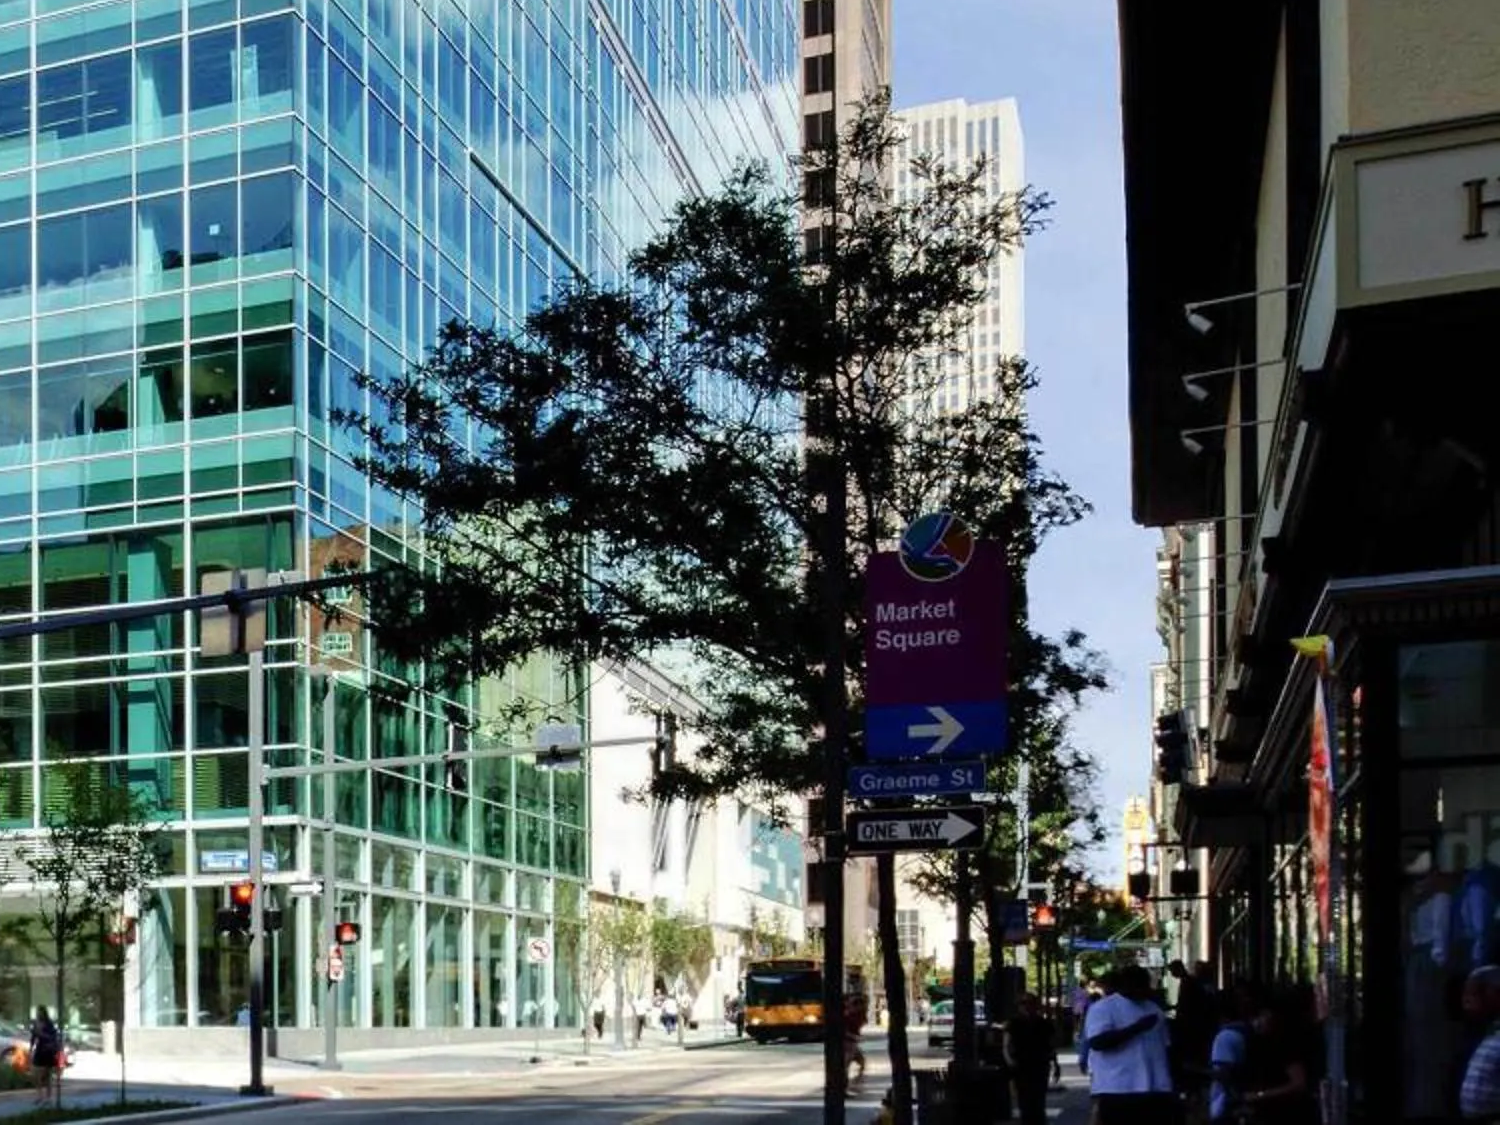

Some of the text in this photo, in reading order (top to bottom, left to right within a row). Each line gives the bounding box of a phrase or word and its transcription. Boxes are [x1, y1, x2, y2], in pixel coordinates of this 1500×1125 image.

[875, 598, 956, 623] Market
[875, 628, 962, 652] Square
[859, 768, 973, 792] Graeme St
[862, 821, 944, 840] ONE WAY
